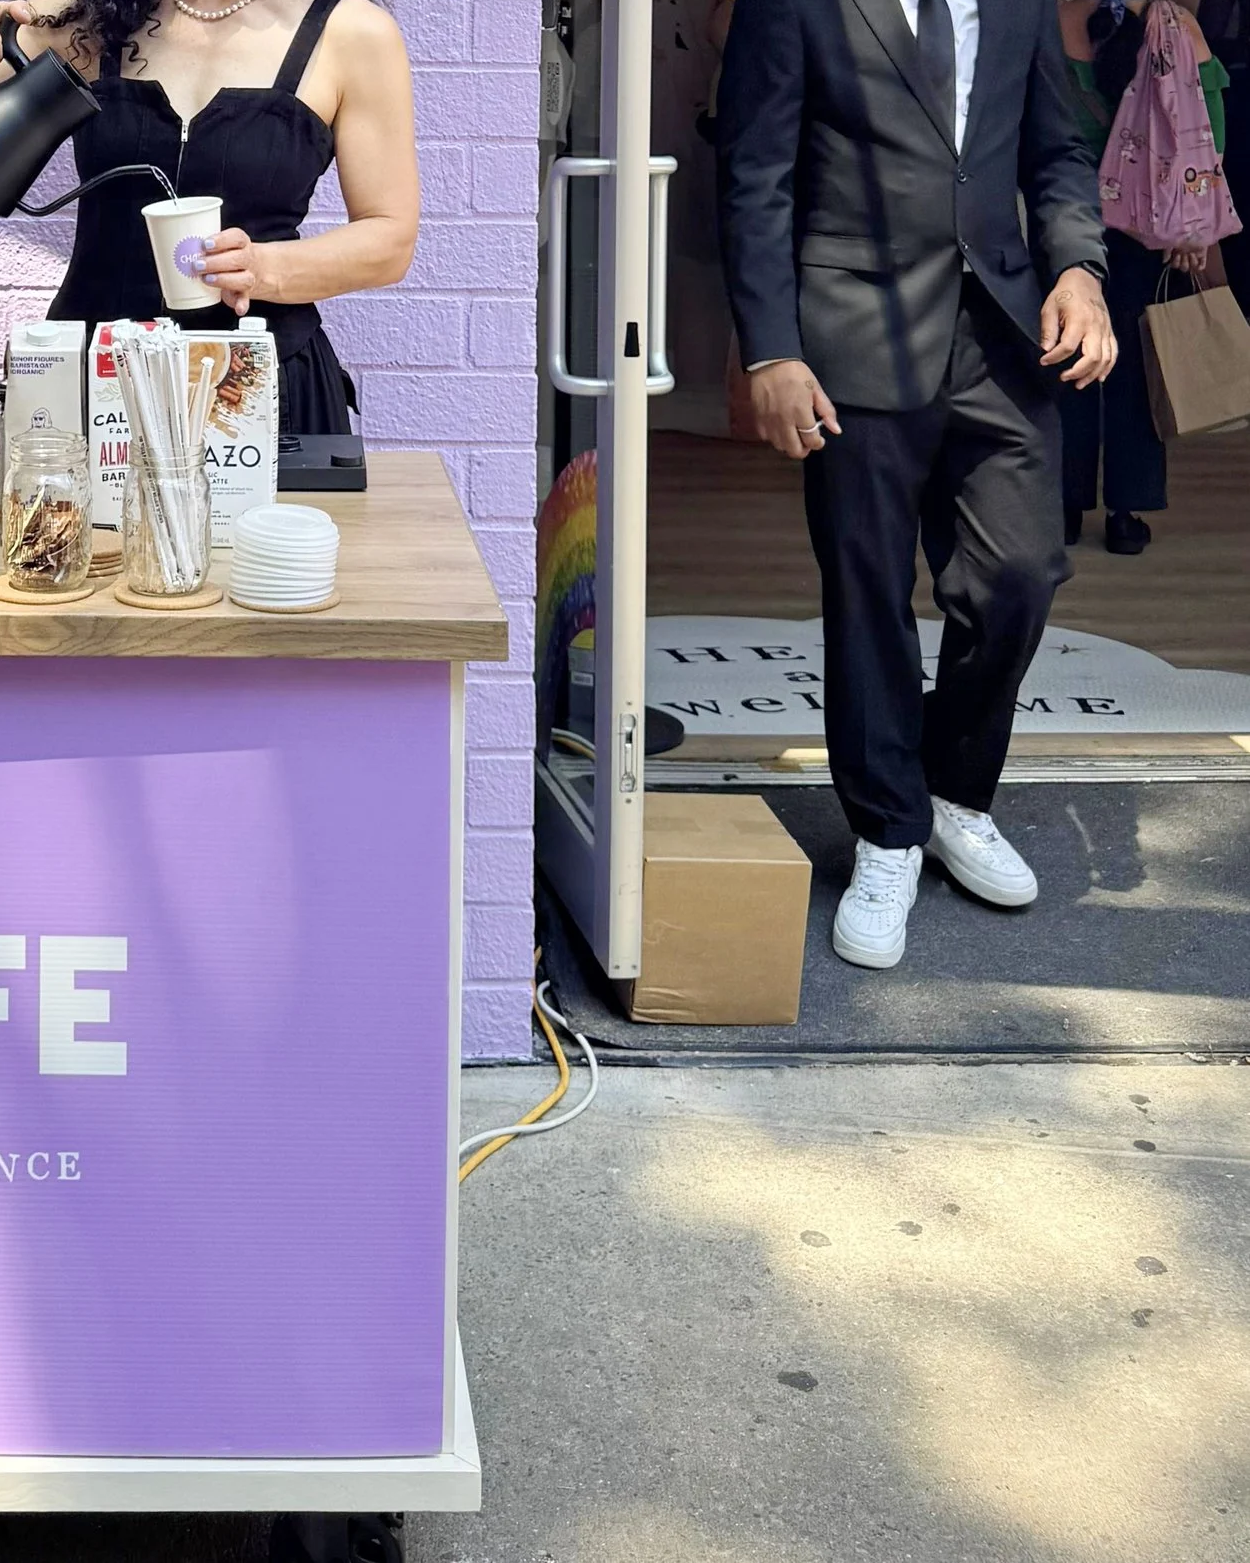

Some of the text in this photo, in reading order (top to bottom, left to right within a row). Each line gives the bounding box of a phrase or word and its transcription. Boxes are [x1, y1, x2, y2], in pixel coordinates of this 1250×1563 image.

[180, 253, 198, 264] CHA
[93, 412, 128, 427] CAL
[99, 441, 129, 467] ALM
[204, 445, 261, 468] AZO
[102, 472, 126, 482] BAR
